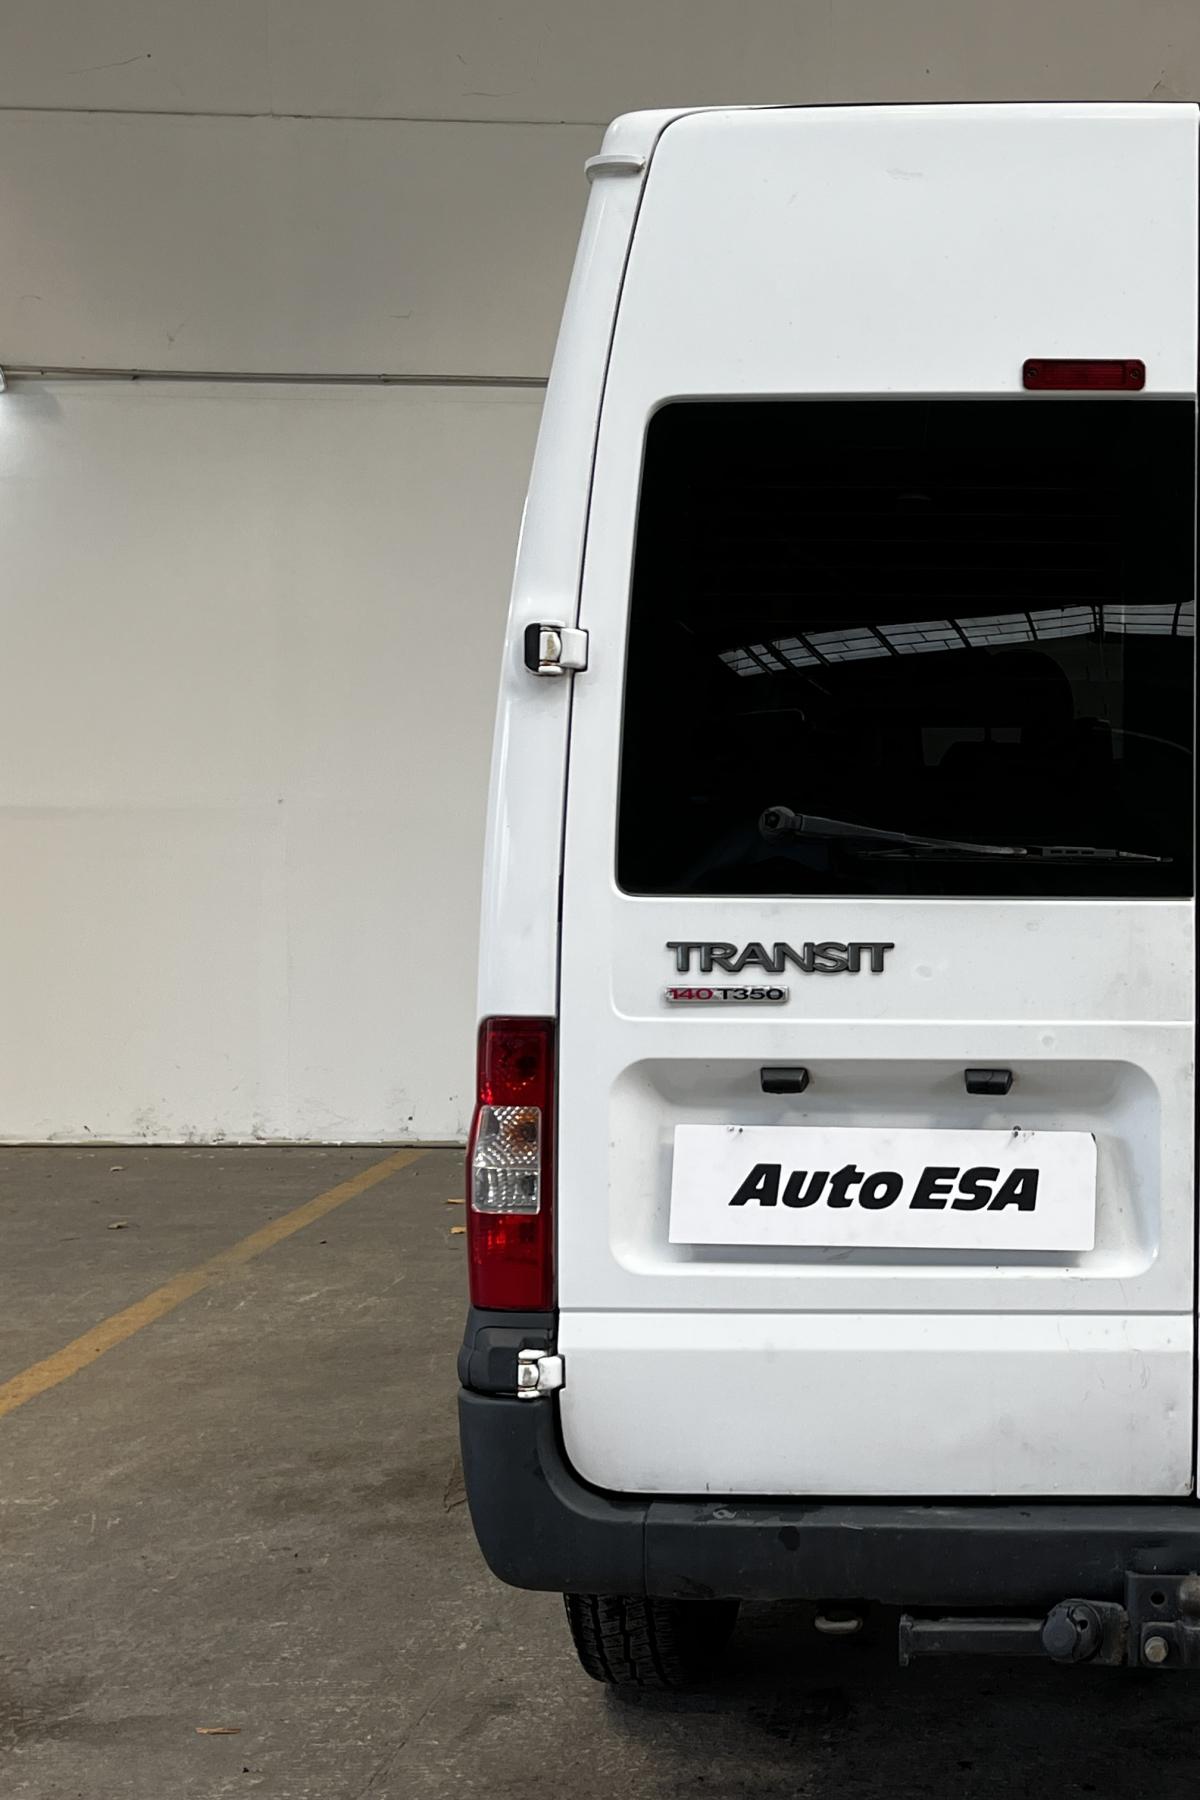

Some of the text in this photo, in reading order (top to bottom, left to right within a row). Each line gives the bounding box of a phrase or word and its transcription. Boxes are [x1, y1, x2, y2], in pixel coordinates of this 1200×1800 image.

[666, 941, 895, 973] TRANSIT
[670, 987, 784, 1000] 140 T350
[728, 1163, 1040, 1211] Auto ESA
